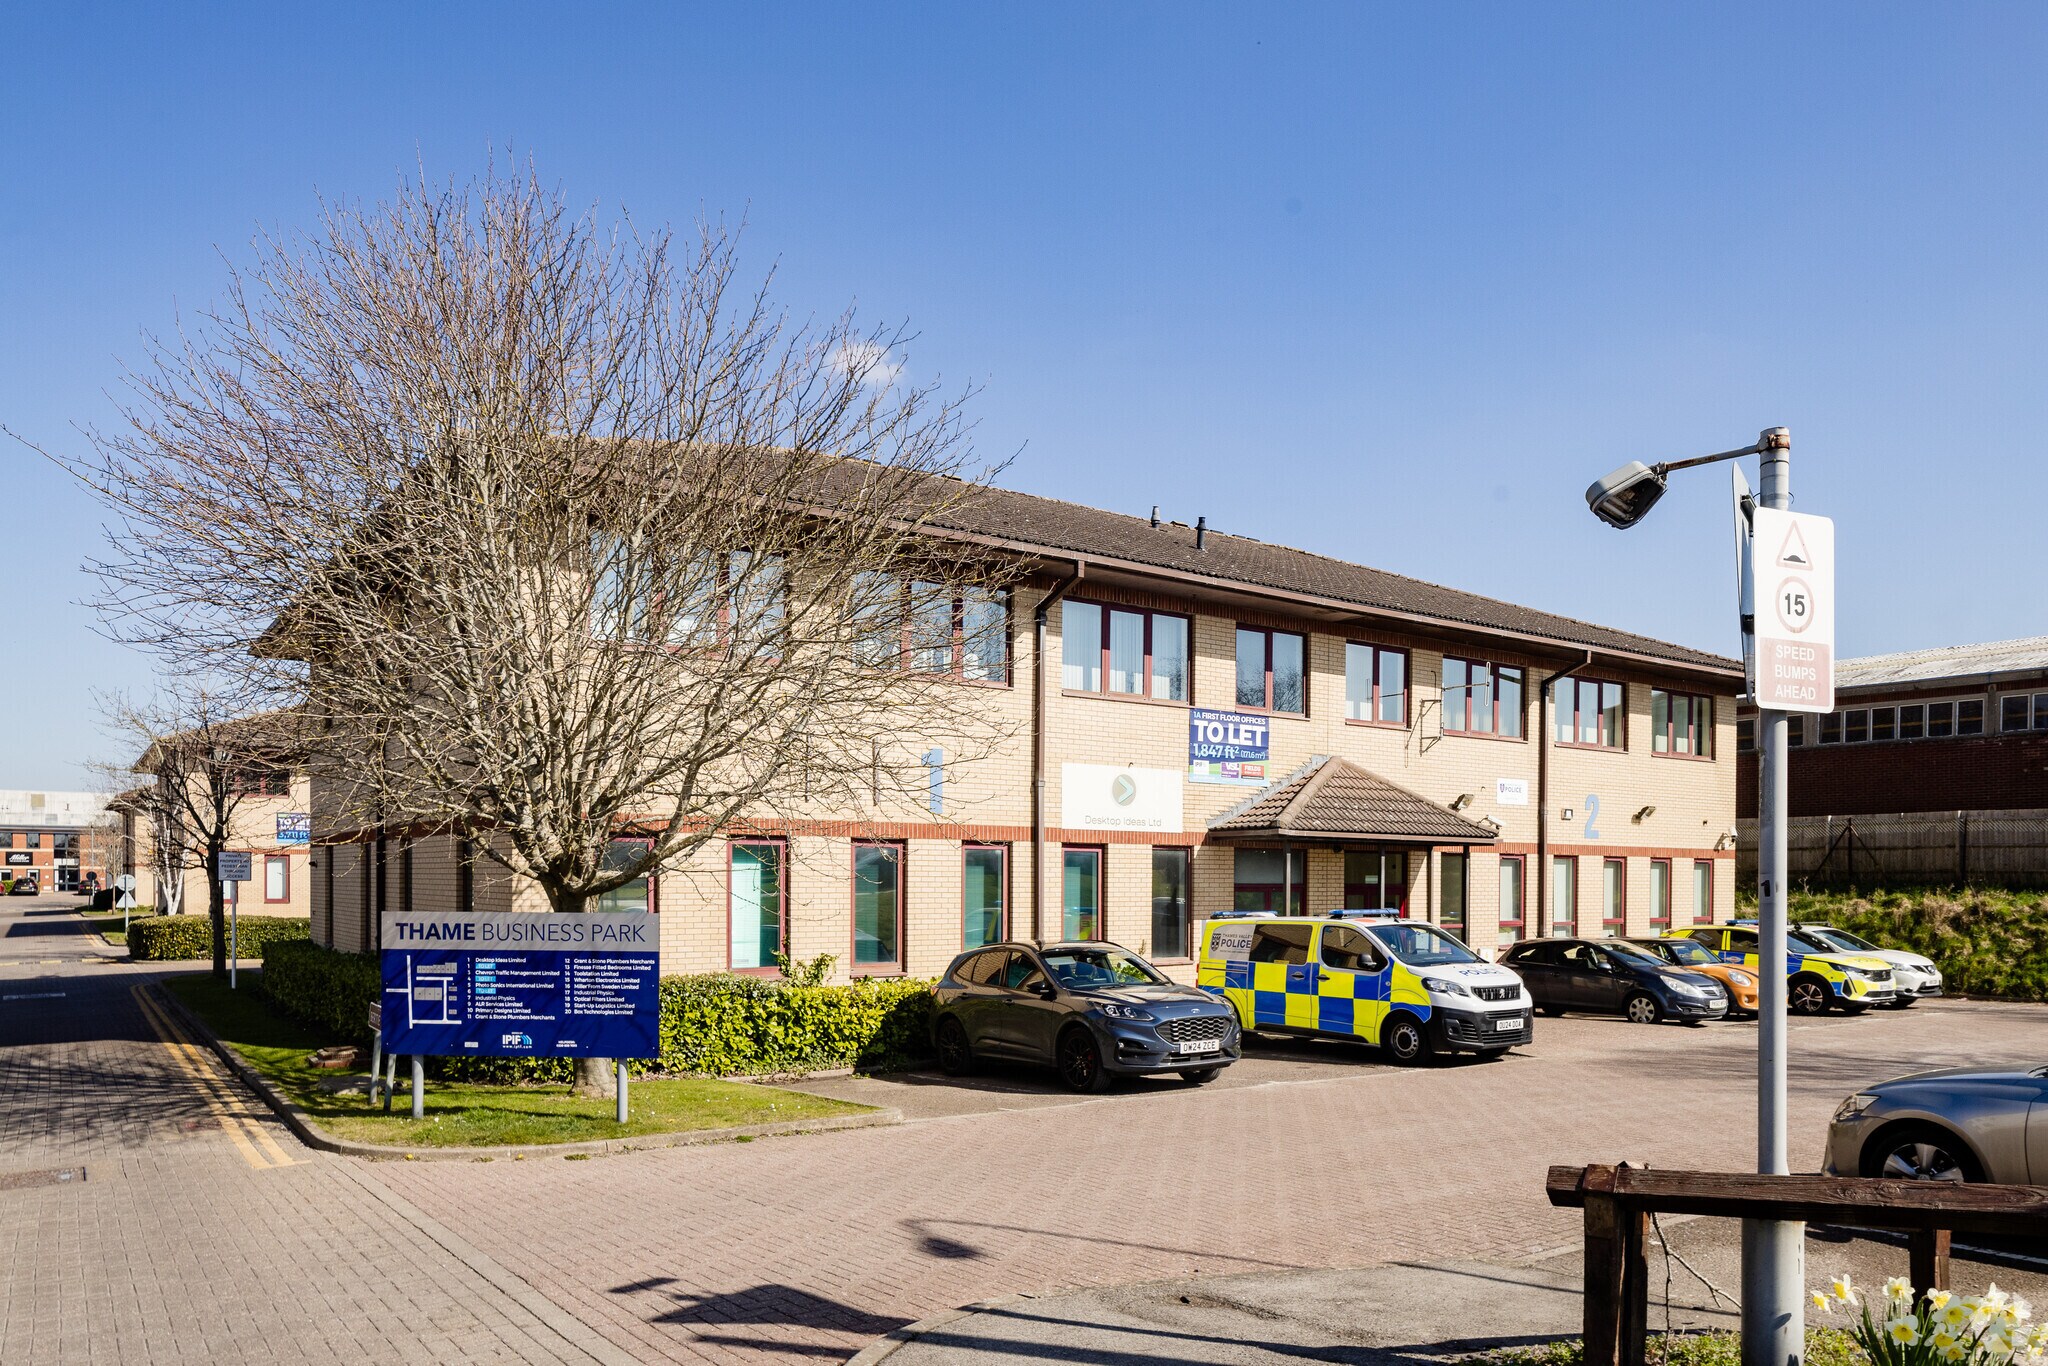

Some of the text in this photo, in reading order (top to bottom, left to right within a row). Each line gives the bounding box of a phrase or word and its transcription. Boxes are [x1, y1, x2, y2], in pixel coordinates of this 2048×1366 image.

[1785, 593, 1805, 616] 15
[1776, 644, 1814, 661] SPEED
[1775, 664, 1816, 681] BUMPS
[1775, 684, 1816, 700] AHEAD
[1202, 712, 1219, 720] FIRST
[1220, 714, 1240, 722] FLOOR
[1241, 717, 1265, 725] OFFICES
[1194, 720, 1265, 746] TO LET
[1193, 744, 1223, 758] 1,847
[921, 748, 943, 814] 1
[1085, 815, 1161, 826] Desktop Ideas Ltd
[1584, 794, 1599, 839] 2
[396, 922, 645, 942] THAME BUSINESS PARK
[1220, 939, 1251, 948] POLICE
[502, 1034, 521, 1044] IPIF
